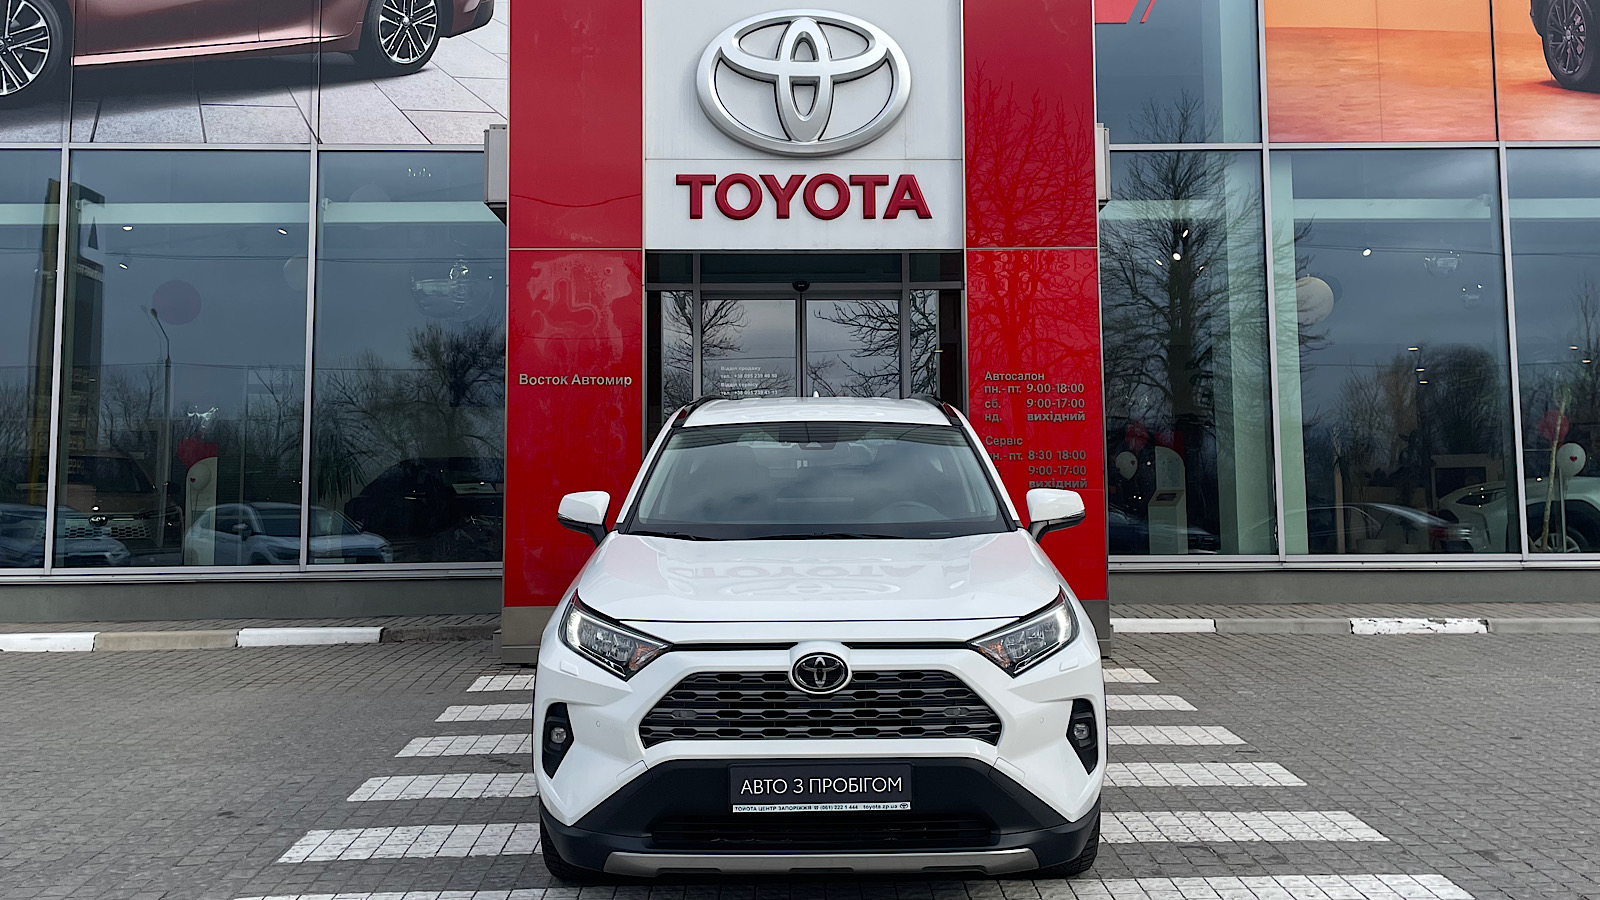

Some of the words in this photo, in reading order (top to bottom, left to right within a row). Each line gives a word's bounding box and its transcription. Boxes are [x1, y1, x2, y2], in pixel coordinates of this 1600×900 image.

[675, 173, 933, 220] TOYOTA
[519, 373, 569, 386] Восток
[571, 373, 632, 389] Автомир
[984, 371, 1045, 381] Автосалон
[984, 400, 1002, 409] сб.
[1026, 398, 1085, 408] 9:00-17:00
[984, 413, 1002, 423] нд.
[1027, 410, 1086, 423] вихідний
[985, 435, 1023, 447] Сервіс
[1028, 465, 1087, 475] 9:00-17:00
[1028, 478, 1088, 489] вихідний
[740, 778, 788, 795] АВТО
[809, 776, 903, 793] ПРОБІГОМ
